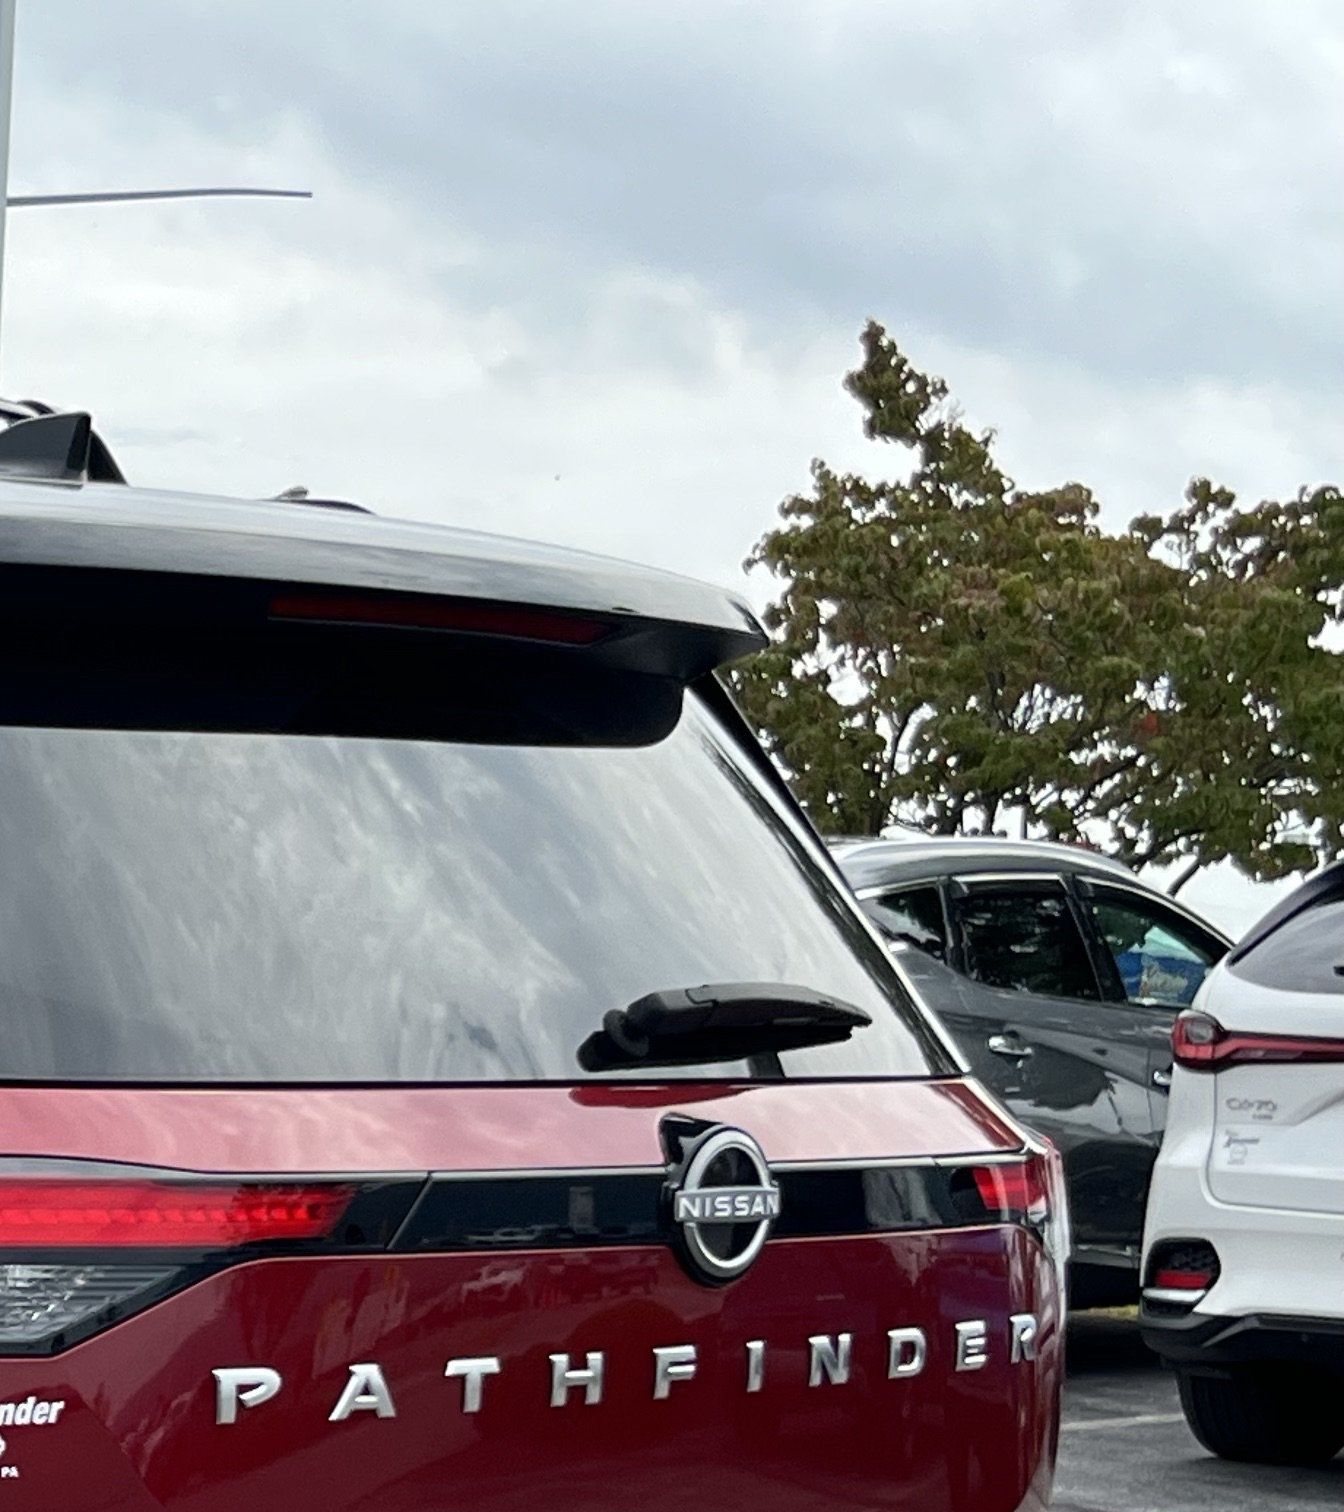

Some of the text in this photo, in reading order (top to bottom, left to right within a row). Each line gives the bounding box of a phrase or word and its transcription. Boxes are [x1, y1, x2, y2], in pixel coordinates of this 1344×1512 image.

[678, 1194, 780, 1219] NISSAN
[210, 1313, 1037, 1425] PATHFINDER
[0, 1465, 19, 1478] PA
